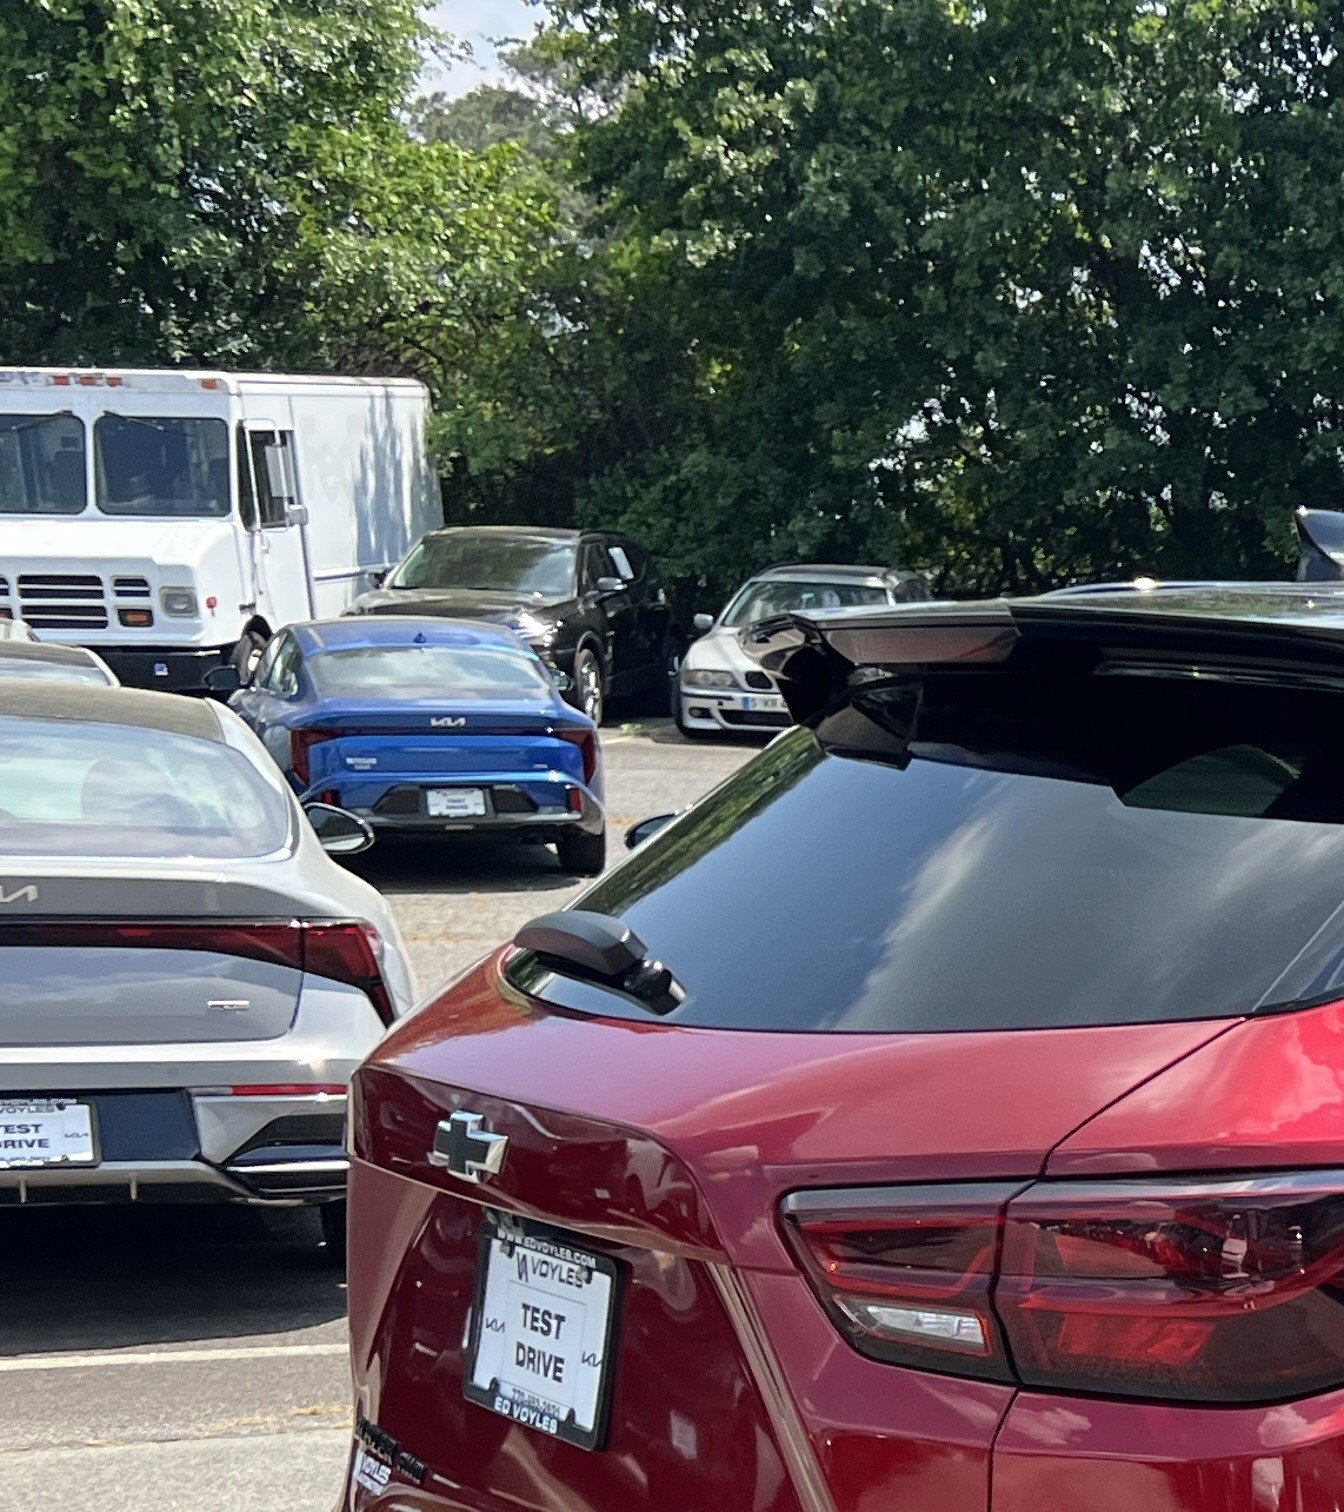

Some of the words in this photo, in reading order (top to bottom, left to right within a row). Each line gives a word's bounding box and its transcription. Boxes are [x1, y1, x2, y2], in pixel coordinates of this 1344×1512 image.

[0, 1138, 50, 1149] RIVE
[521, 1302, 566, 1340] TEST
[515, 1340, 566, 1383] DRIVE
